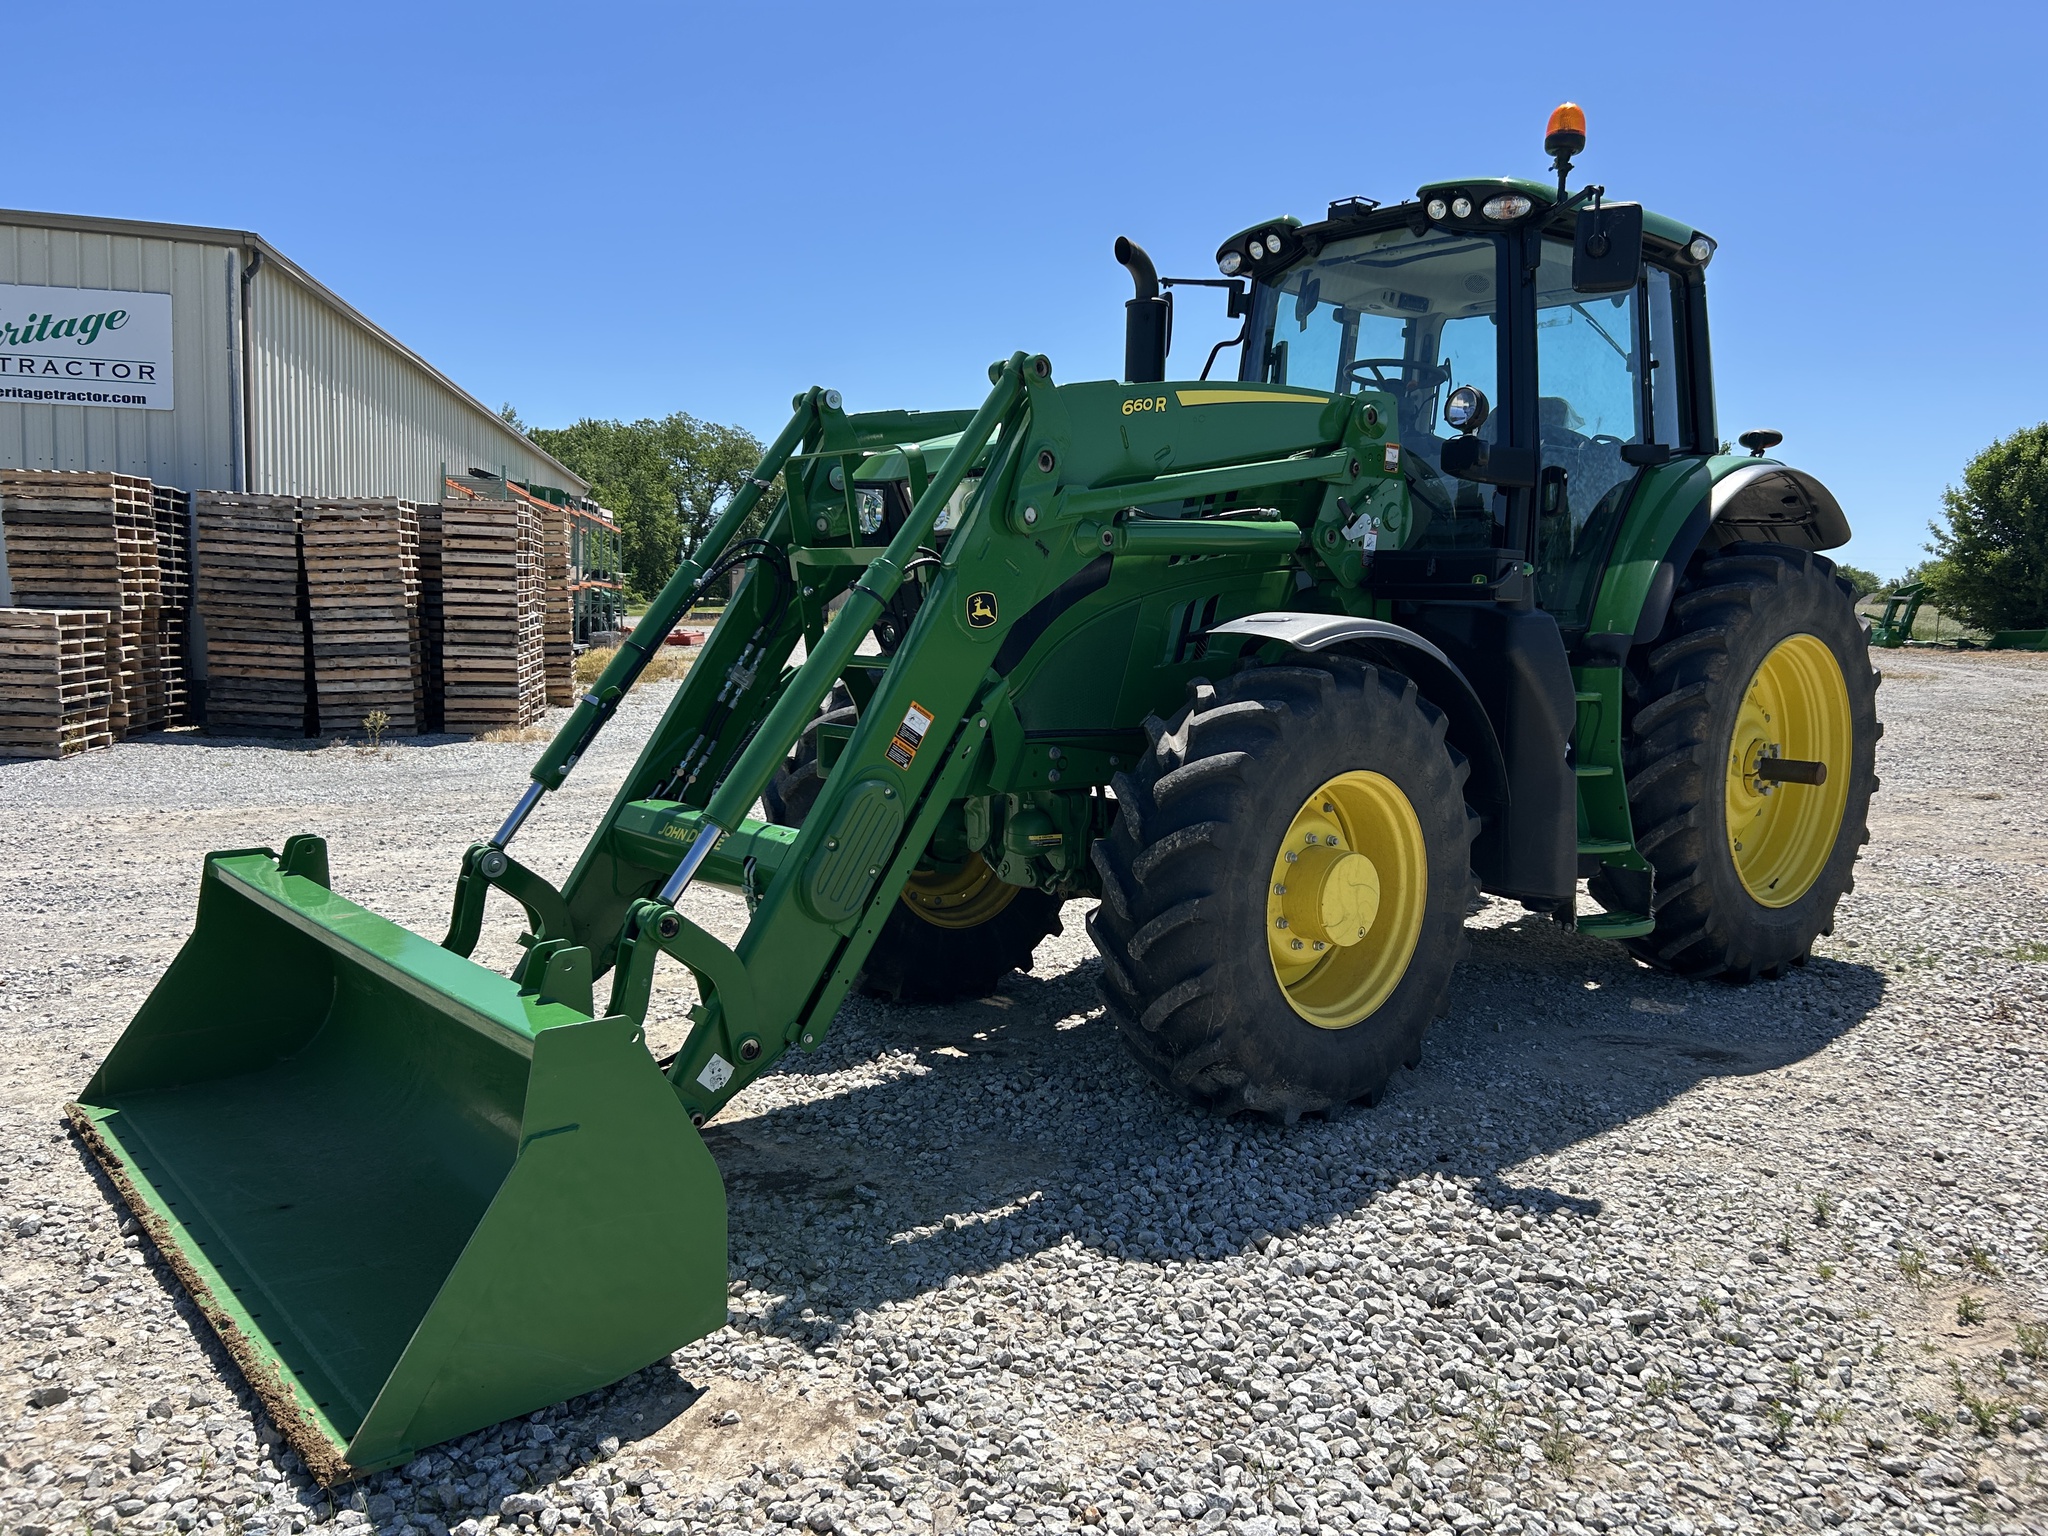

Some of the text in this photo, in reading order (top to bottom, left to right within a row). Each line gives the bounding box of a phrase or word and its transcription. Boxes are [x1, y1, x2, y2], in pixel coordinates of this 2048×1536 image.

[0, 309, 130, 346] ritage
[0, 357, 156, 380] TRACTOR
[658, 822, 688, 841] JOHN
